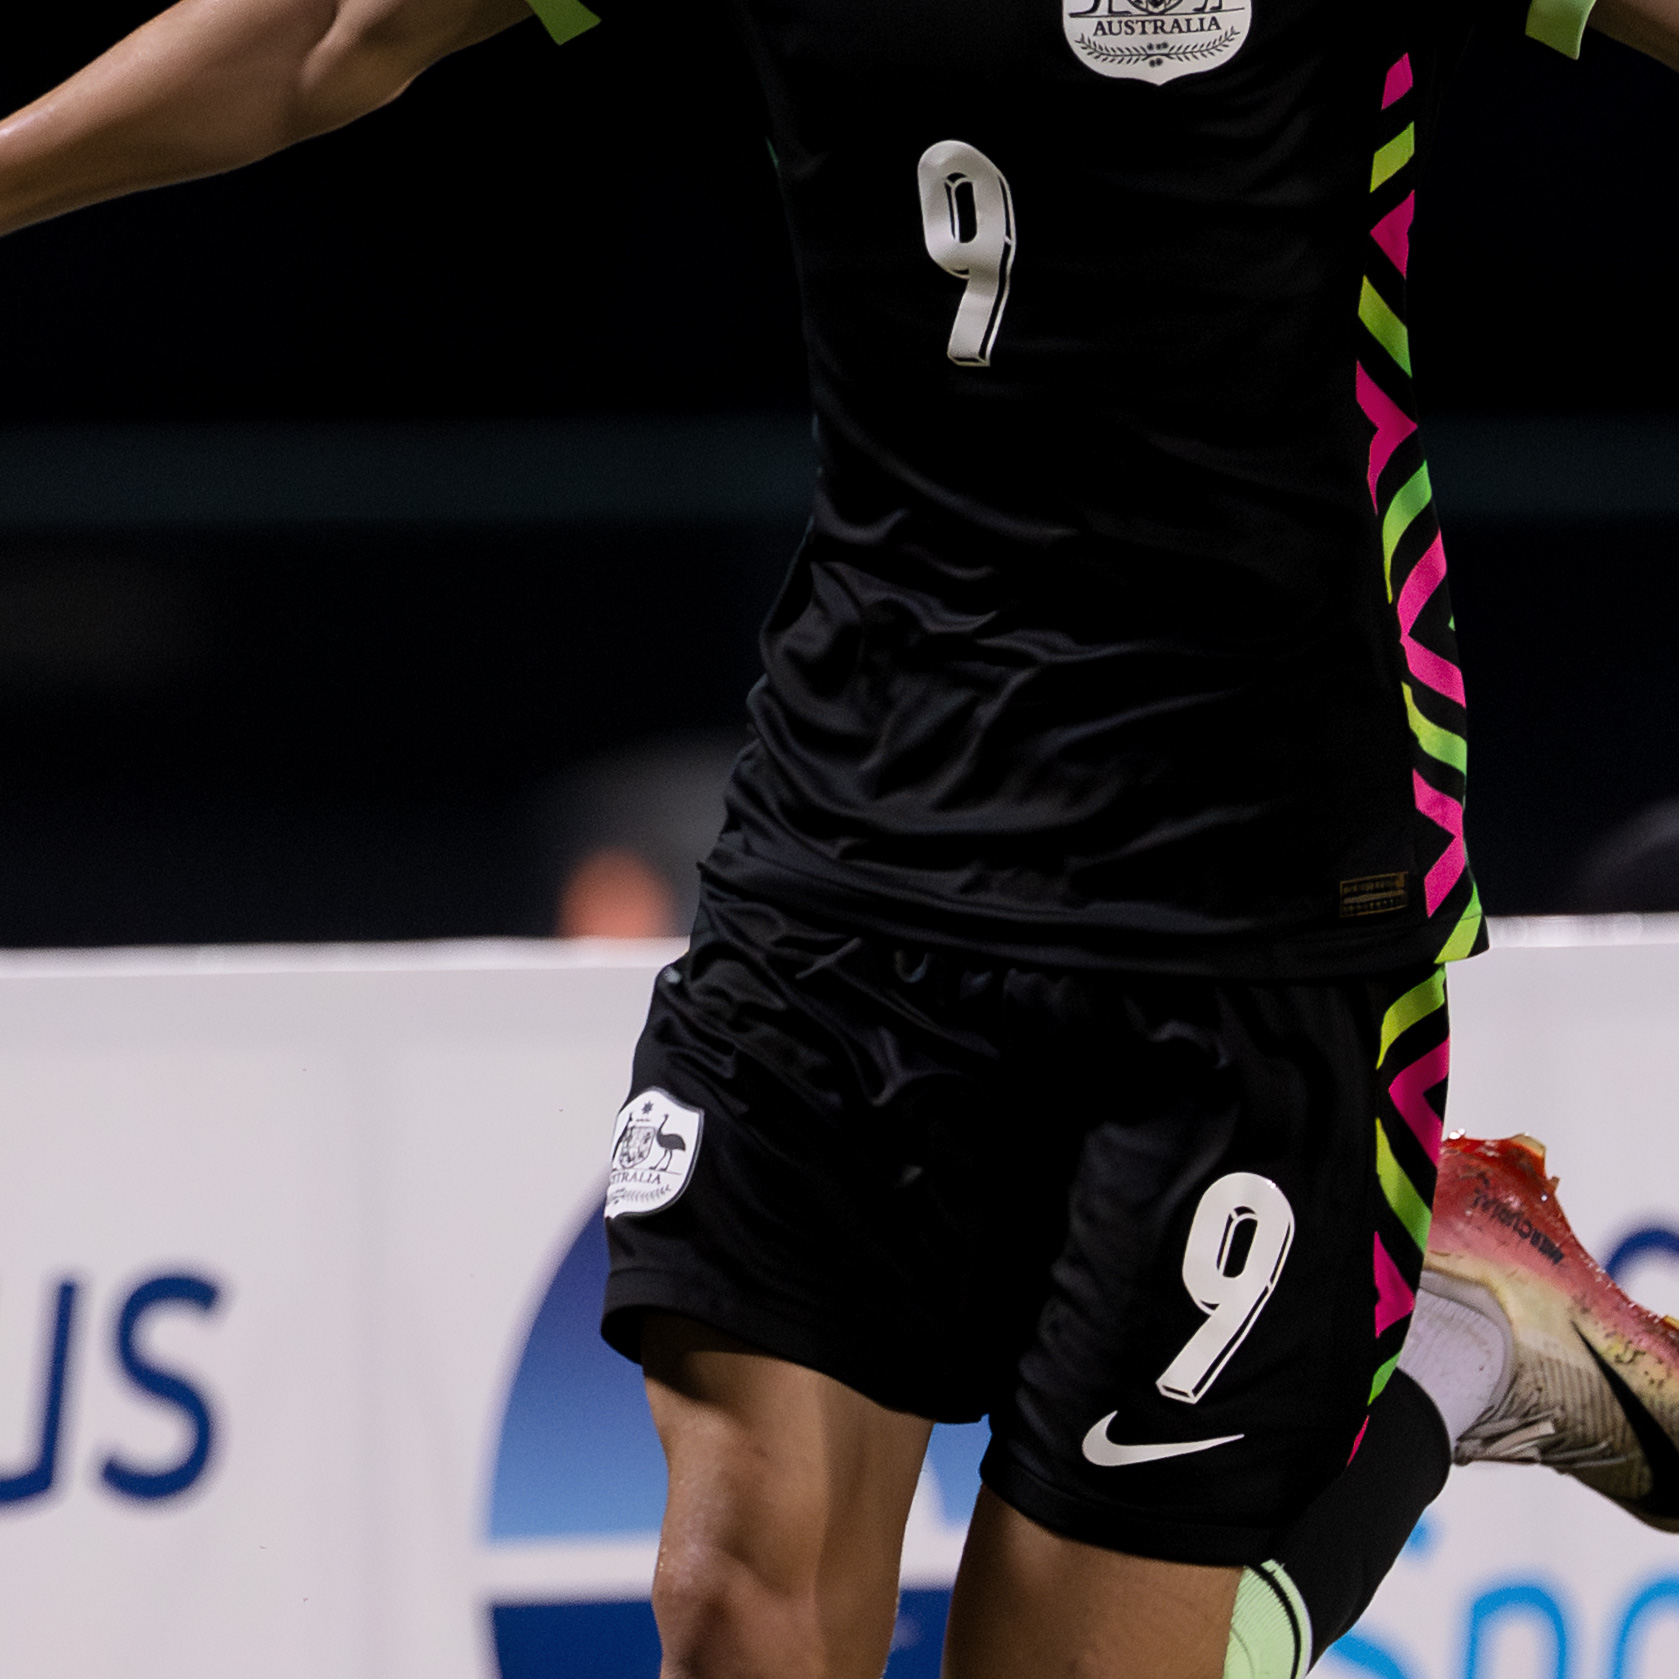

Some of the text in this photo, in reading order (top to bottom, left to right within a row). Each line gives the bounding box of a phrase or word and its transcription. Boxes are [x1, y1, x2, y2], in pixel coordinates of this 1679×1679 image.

[1092, 15, 1222, 37] AUSTRALIA
[917, 139, 1017, 367] 9
[1155, 1171, 1296, 1405] 9
